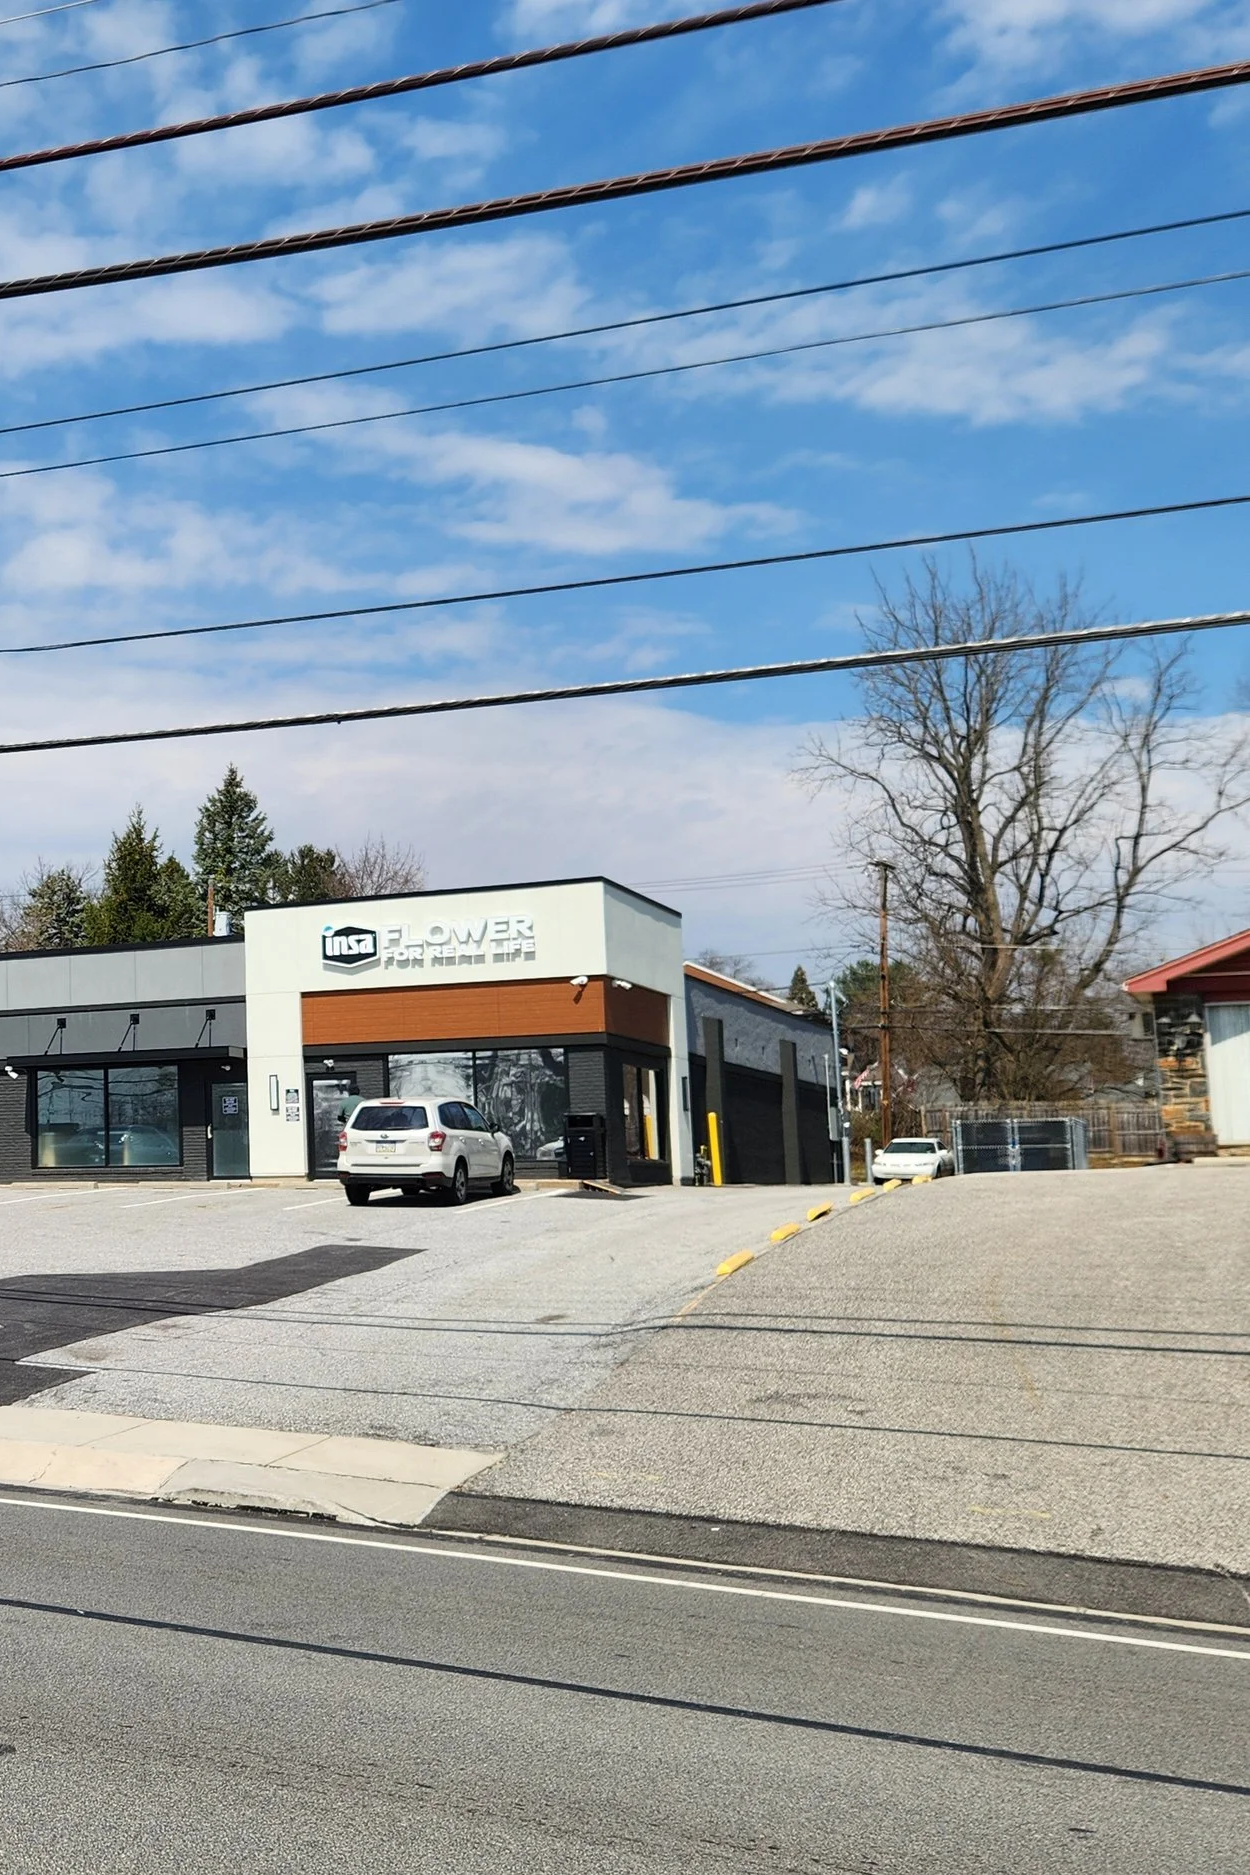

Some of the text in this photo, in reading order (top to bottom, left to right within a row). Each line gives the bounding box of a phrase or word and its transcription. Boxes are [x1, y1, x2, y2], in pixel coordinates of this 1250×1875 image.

[323, 926, 376, 957] insa
[381, 915, 534, 947] FLOWER
[381, 938, 536, 961] FOR REAL LIFE
